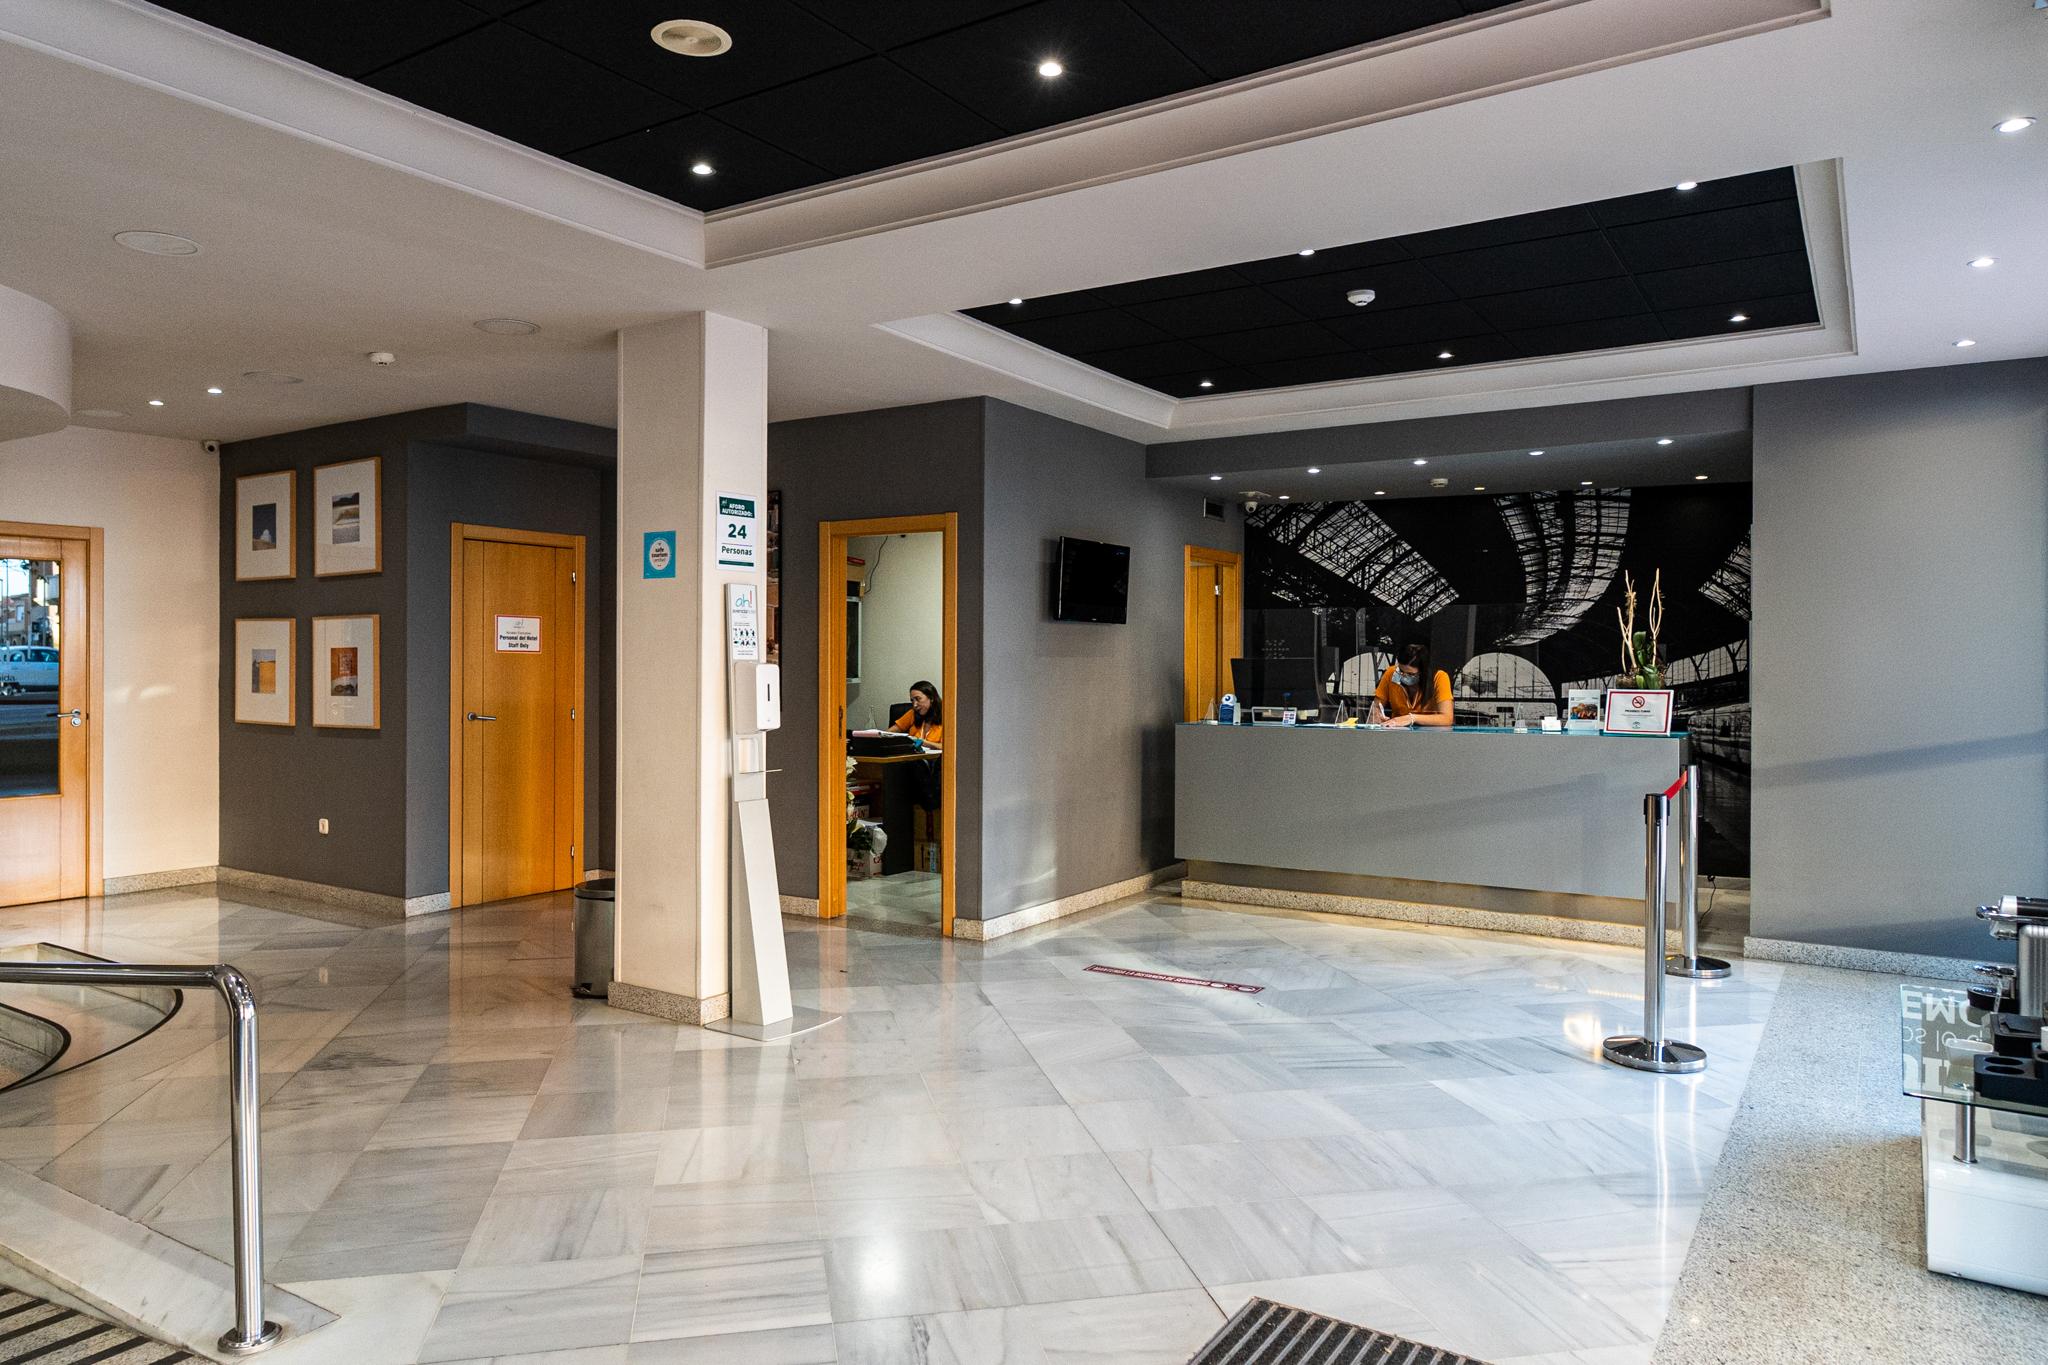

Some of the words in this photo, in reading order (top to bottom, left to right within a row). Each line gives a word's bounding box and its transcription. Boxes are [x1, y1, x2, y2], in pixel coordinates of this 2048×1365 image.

[729, 503, 746, 511] AFORO
[728, 523, 747, 539] 24
[721, 545, 753, 556] Personas
